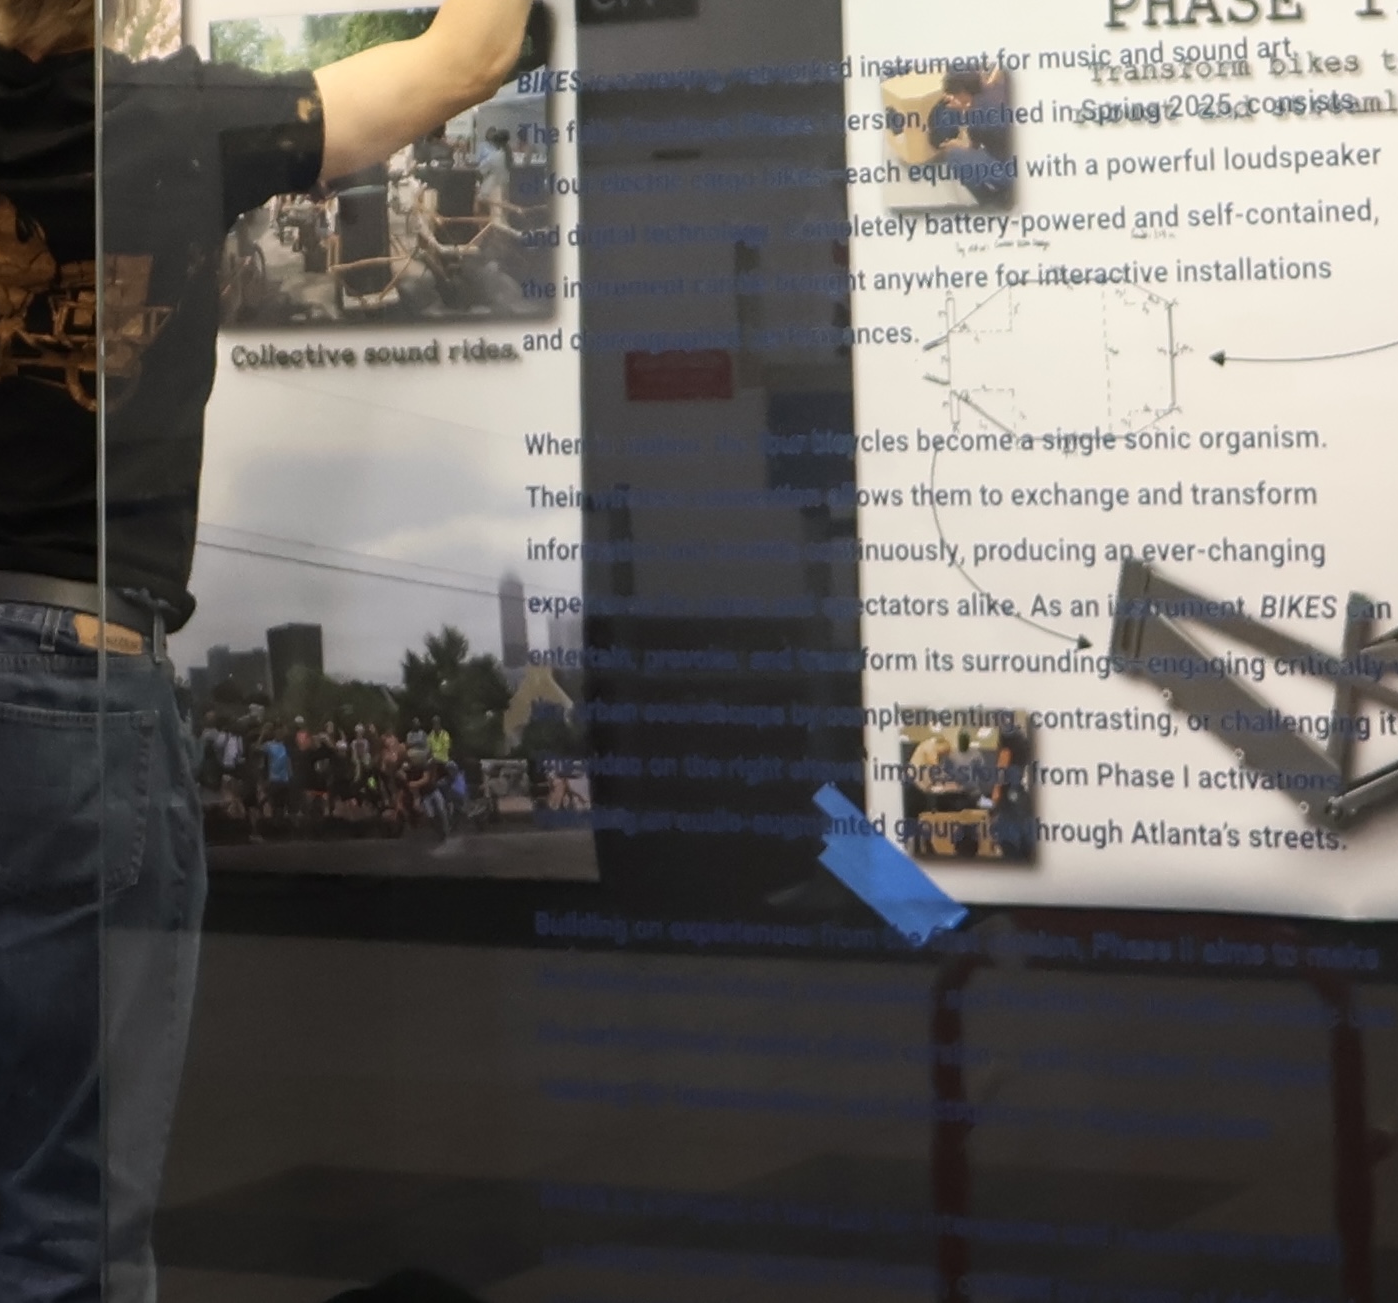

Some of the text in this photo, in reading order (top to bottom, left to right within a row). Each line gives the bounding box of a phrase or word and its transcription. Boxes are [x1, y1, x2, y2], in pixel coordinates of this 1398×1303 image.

[517, 70, 582, 94] BIKES
[860, 50, 989, 79] instrument
[996, 47, 1030, 72] for
[1038, 43, 1112, 70] music
[1120, 41, 1164, 66] and
[1173, 37, 1248, 66] sound
[1269, 50, 1359, 75] bikes
[1053, 101, 1072, 123] in
[1246, 92, 1354, 116] consists
[908, 143, 1382, 191] equipped with a powerful loudspeaker
[925, 199, 1380, 243] battery-powered and self-contained,
[873, 258, 1333, 295] anywhere for interactive installations
[231, 342, 356, 368] Collective
[364, 339, 439, 366] sound
[522, 329, 563, 352] and
[917, 428, 1012, 453] become
[1020, 433, 1034, 451] a
[1042, 427, 1116, 457] single
[1125, 427, 1190, 451] sonic
[1199, 427, 1327, 456] organism.
[911, 484, 972, 507] them
[981, 486, 1005, 507] to
[1011, 482, 1130, 512] exchange
[1137, 482, 1182, 506] and
[1191, 482, 1319, 506] transform
[973, 538, 1096, 567] producing
[1142, 539, 1326, 568] ever-changing
[1031, 594, 1061, 617] As
[1070, 598, 1099, 618] an
[1260, 595, 1337, 618] BIKES
[925, 650, 1383, 680] its critically
[1031, 709, 1179, 736] contrasting,
[1219, 709, 1370, 739] challenging
[1032, 762, 1339, 791] from Phase activations
[1023, 823, 1122, 850] hrough
[1249, 826, 1347, 851] streets.
